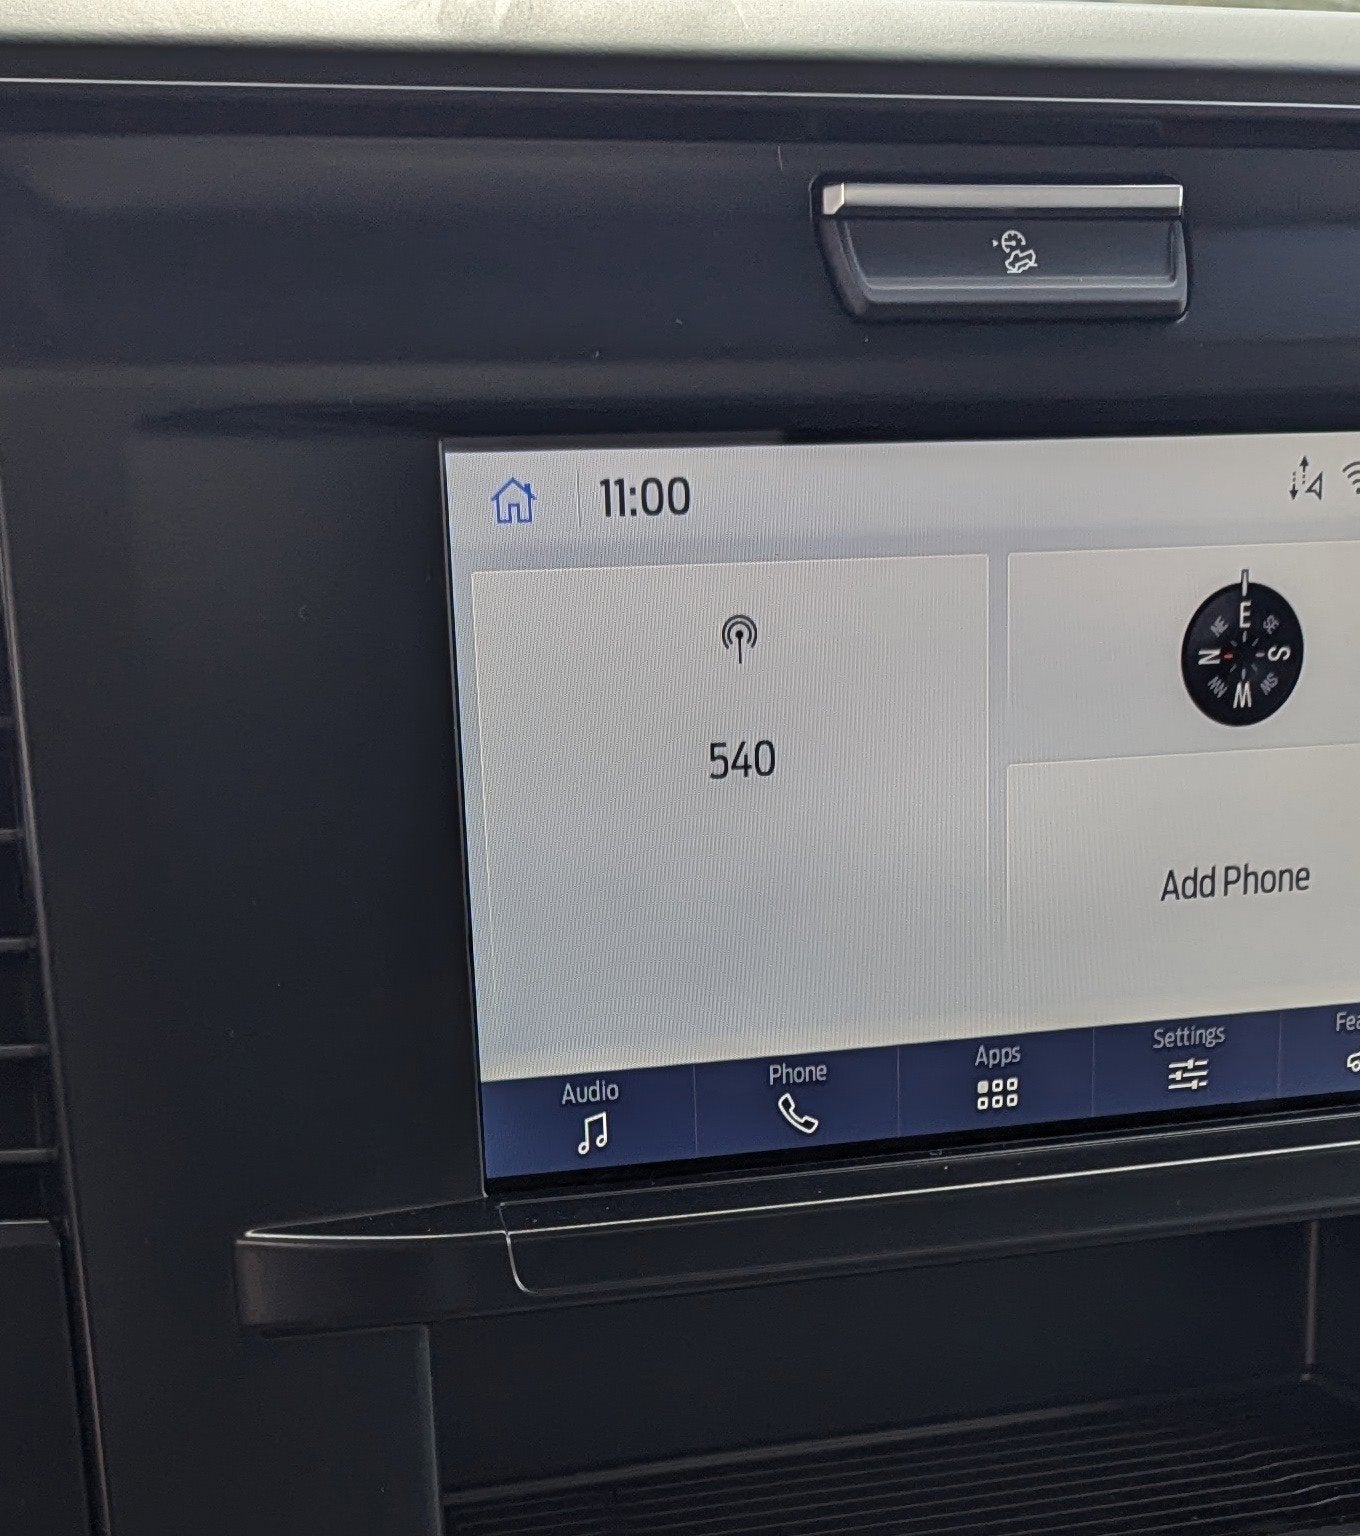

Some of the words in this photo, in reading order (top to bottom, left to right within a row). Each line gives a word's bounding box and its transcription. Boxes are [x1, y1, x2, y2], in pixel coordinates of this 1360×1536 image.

[599, 476, 690, 517] 11:00
[1239, 600, 1251, 628] E
[1198, 648, 1221, 666] N
[1267, 645, 1291, 662] S
[1233, 680, 1252, 708] W
[710, 740, 775, 779] 540
[1160, 864, 1216, 901] Add
[1223, 863, 1311, 896] Phone
[1153, 1025, 1226, 1050] Settings
[975, 1043, 1022, 1068] Apps
[769, 1062, 827, 1086] Phone
[561, 1079, 619, 1105] Audio
